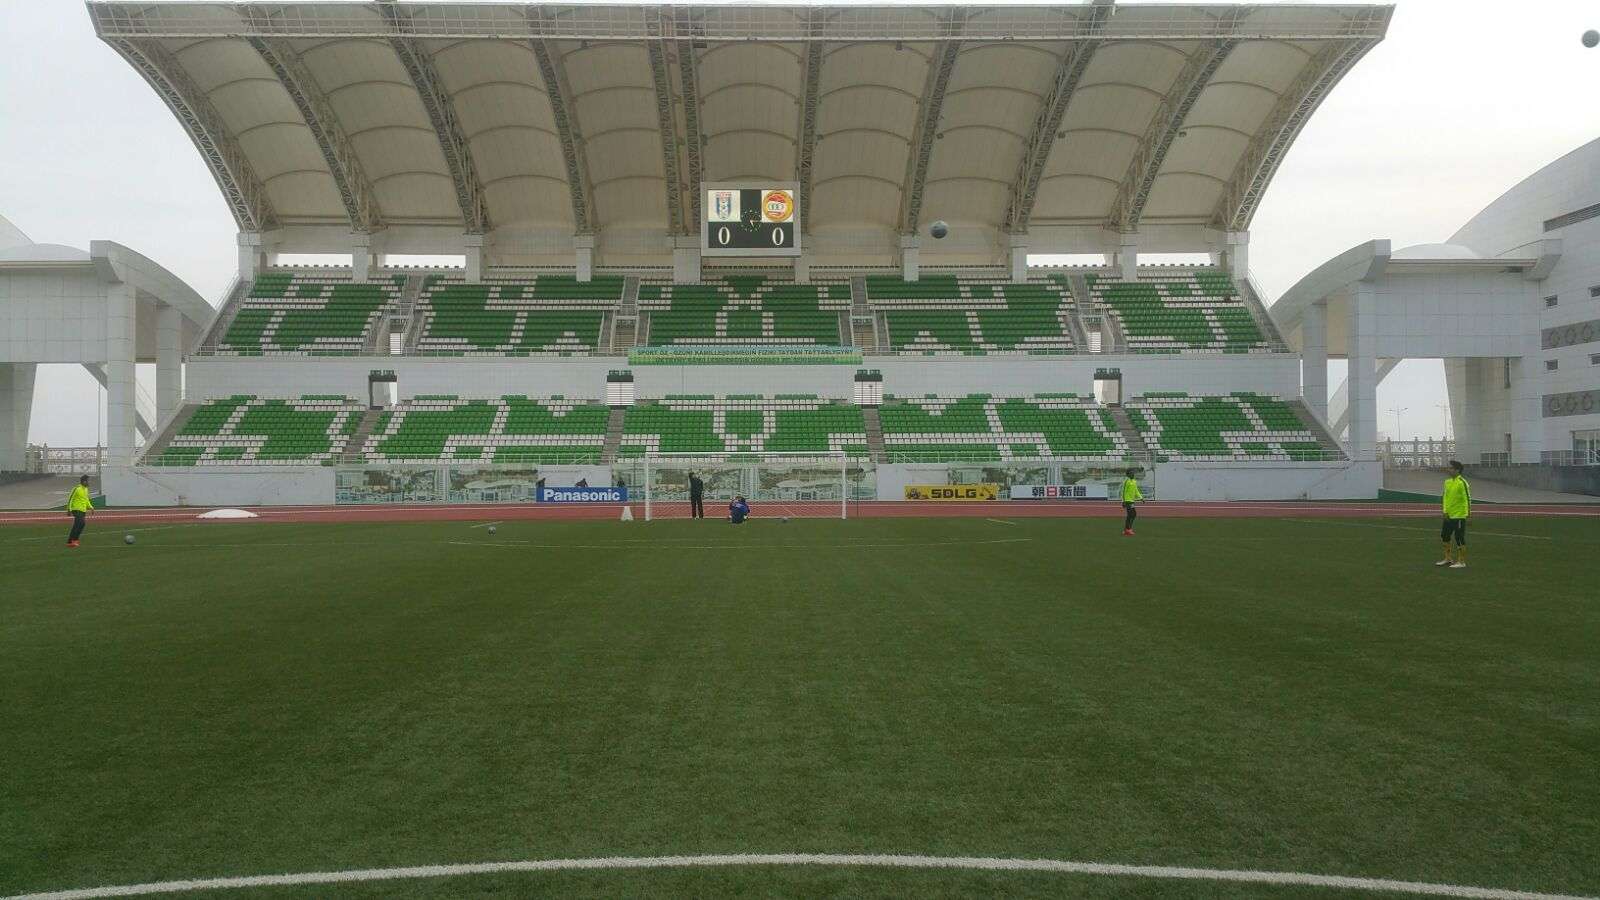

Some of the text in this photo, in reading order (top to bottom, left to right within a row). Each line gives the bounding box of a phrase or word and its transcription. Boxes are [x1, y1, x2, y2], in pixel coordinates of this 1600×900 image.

[718, 226, 731, 245] 0
[772, 227, 785, 246] 0
[543, 488, 620, 501] Panasonic
[931, 488, 976, 498] SDLG
